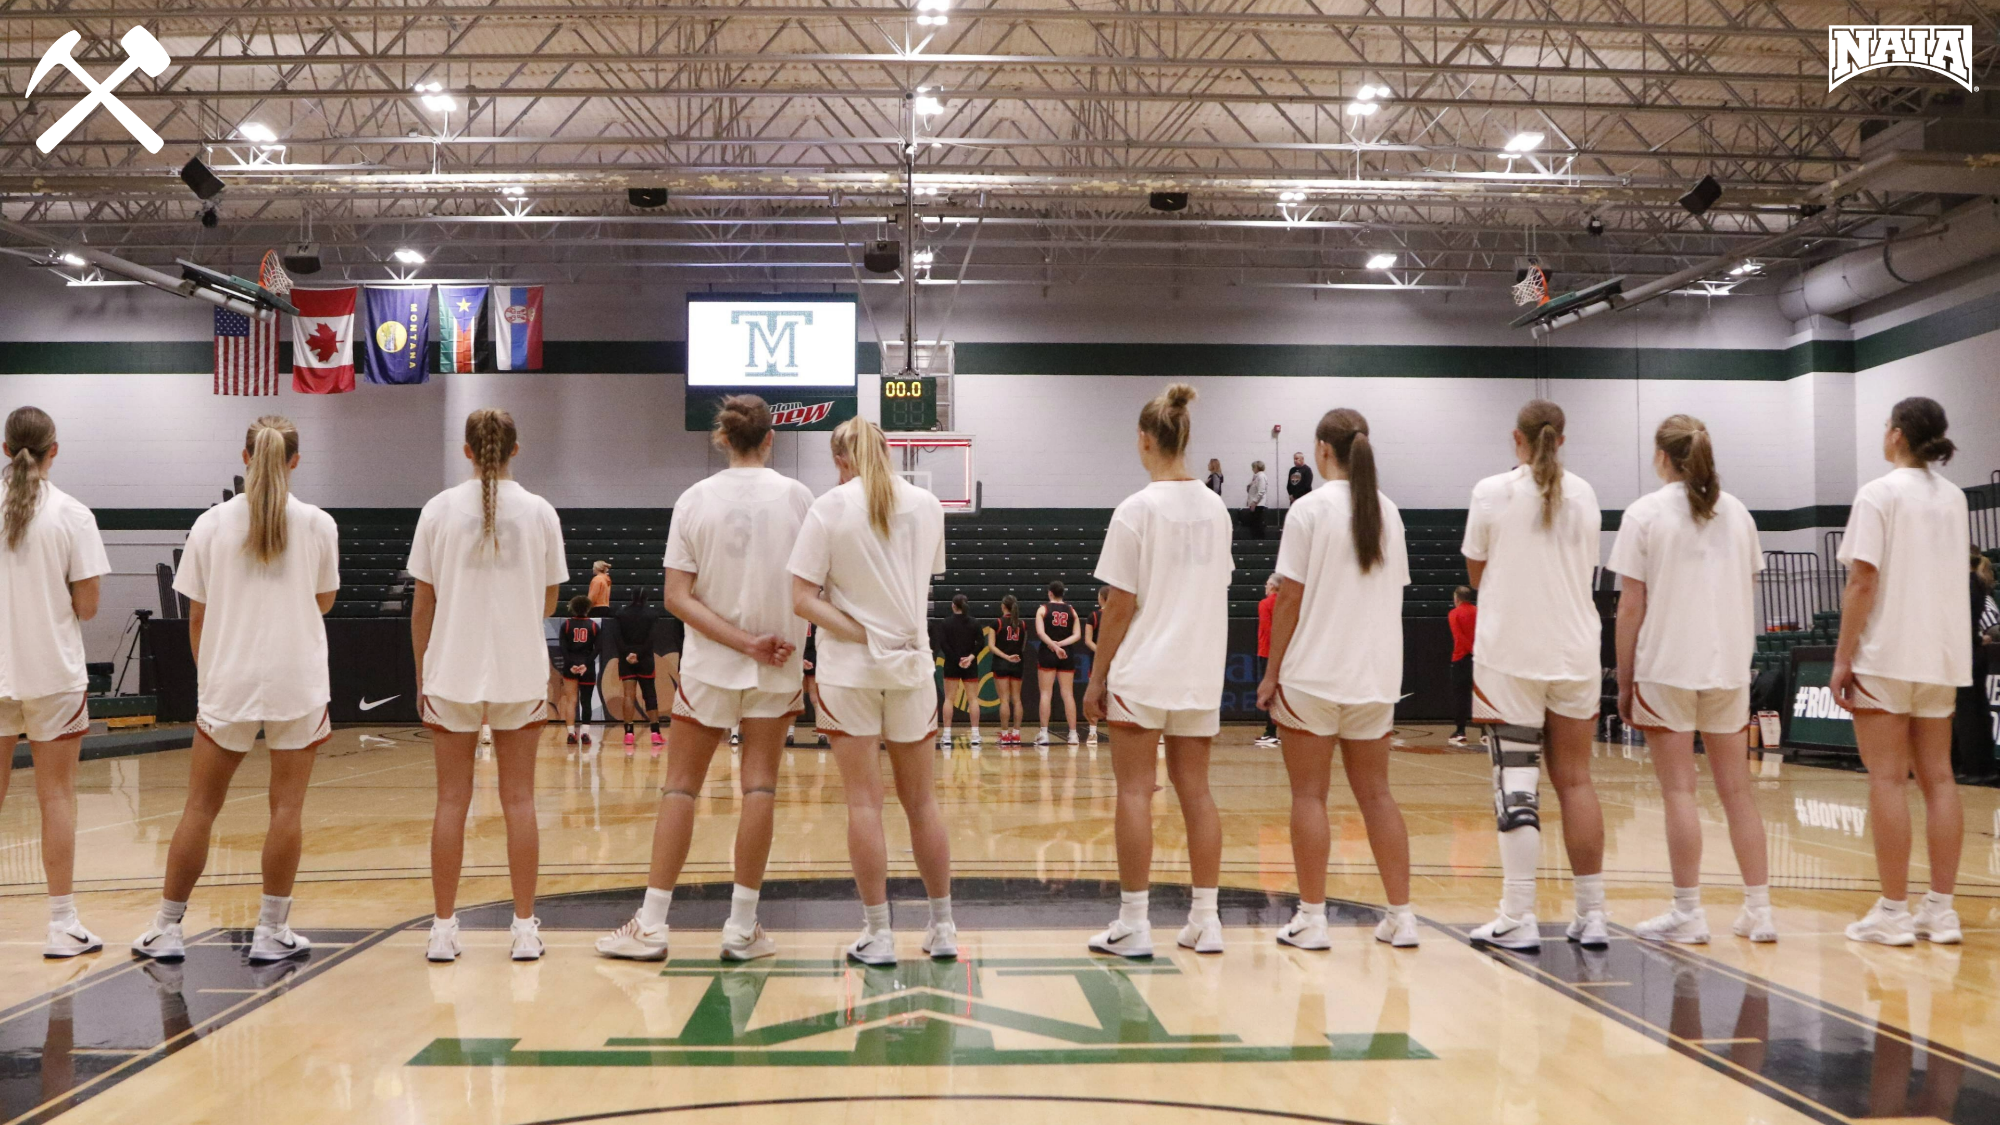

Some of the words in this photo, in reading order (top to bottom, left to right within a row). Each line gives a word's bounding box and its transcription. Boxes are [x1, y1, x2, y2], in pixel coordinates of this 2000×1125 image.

[407, 303, 419, 370] MONTANA
[885, 381, 922, 397] 00.0
[1051, 610, 1069, 628] 32
[572, 627, 588, 643] 10
